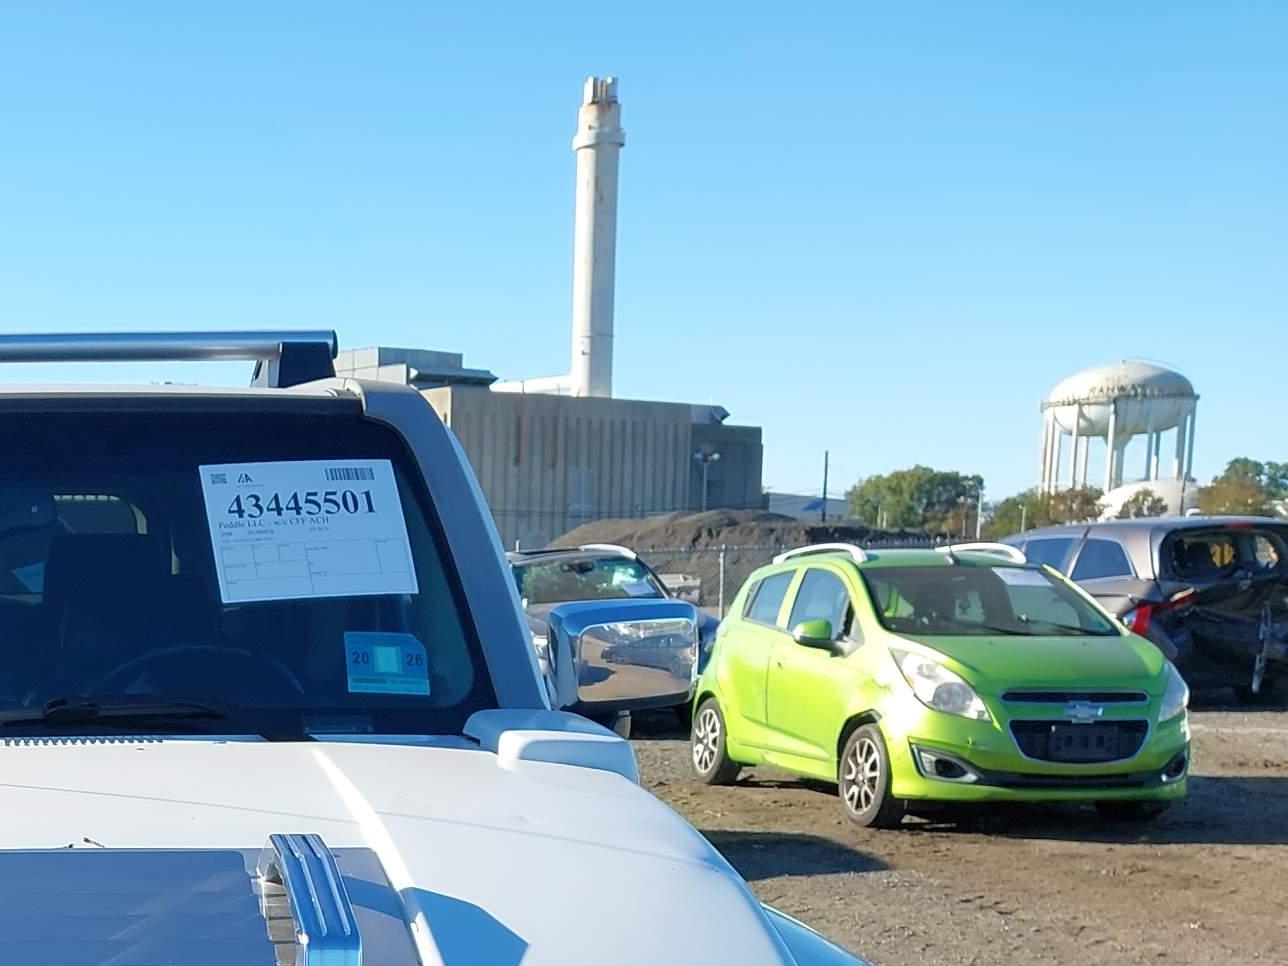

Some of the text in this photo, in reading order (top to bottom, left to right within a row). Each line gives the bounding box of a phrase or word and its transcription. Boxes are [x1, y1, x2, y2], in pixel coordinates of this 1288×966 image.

[228, 489, 377, 518] 43445501
[218, 520, 245, 529] Peddle
[247, 519, 264, 528] LLC
[352, 651, 424, 666] 20 26
